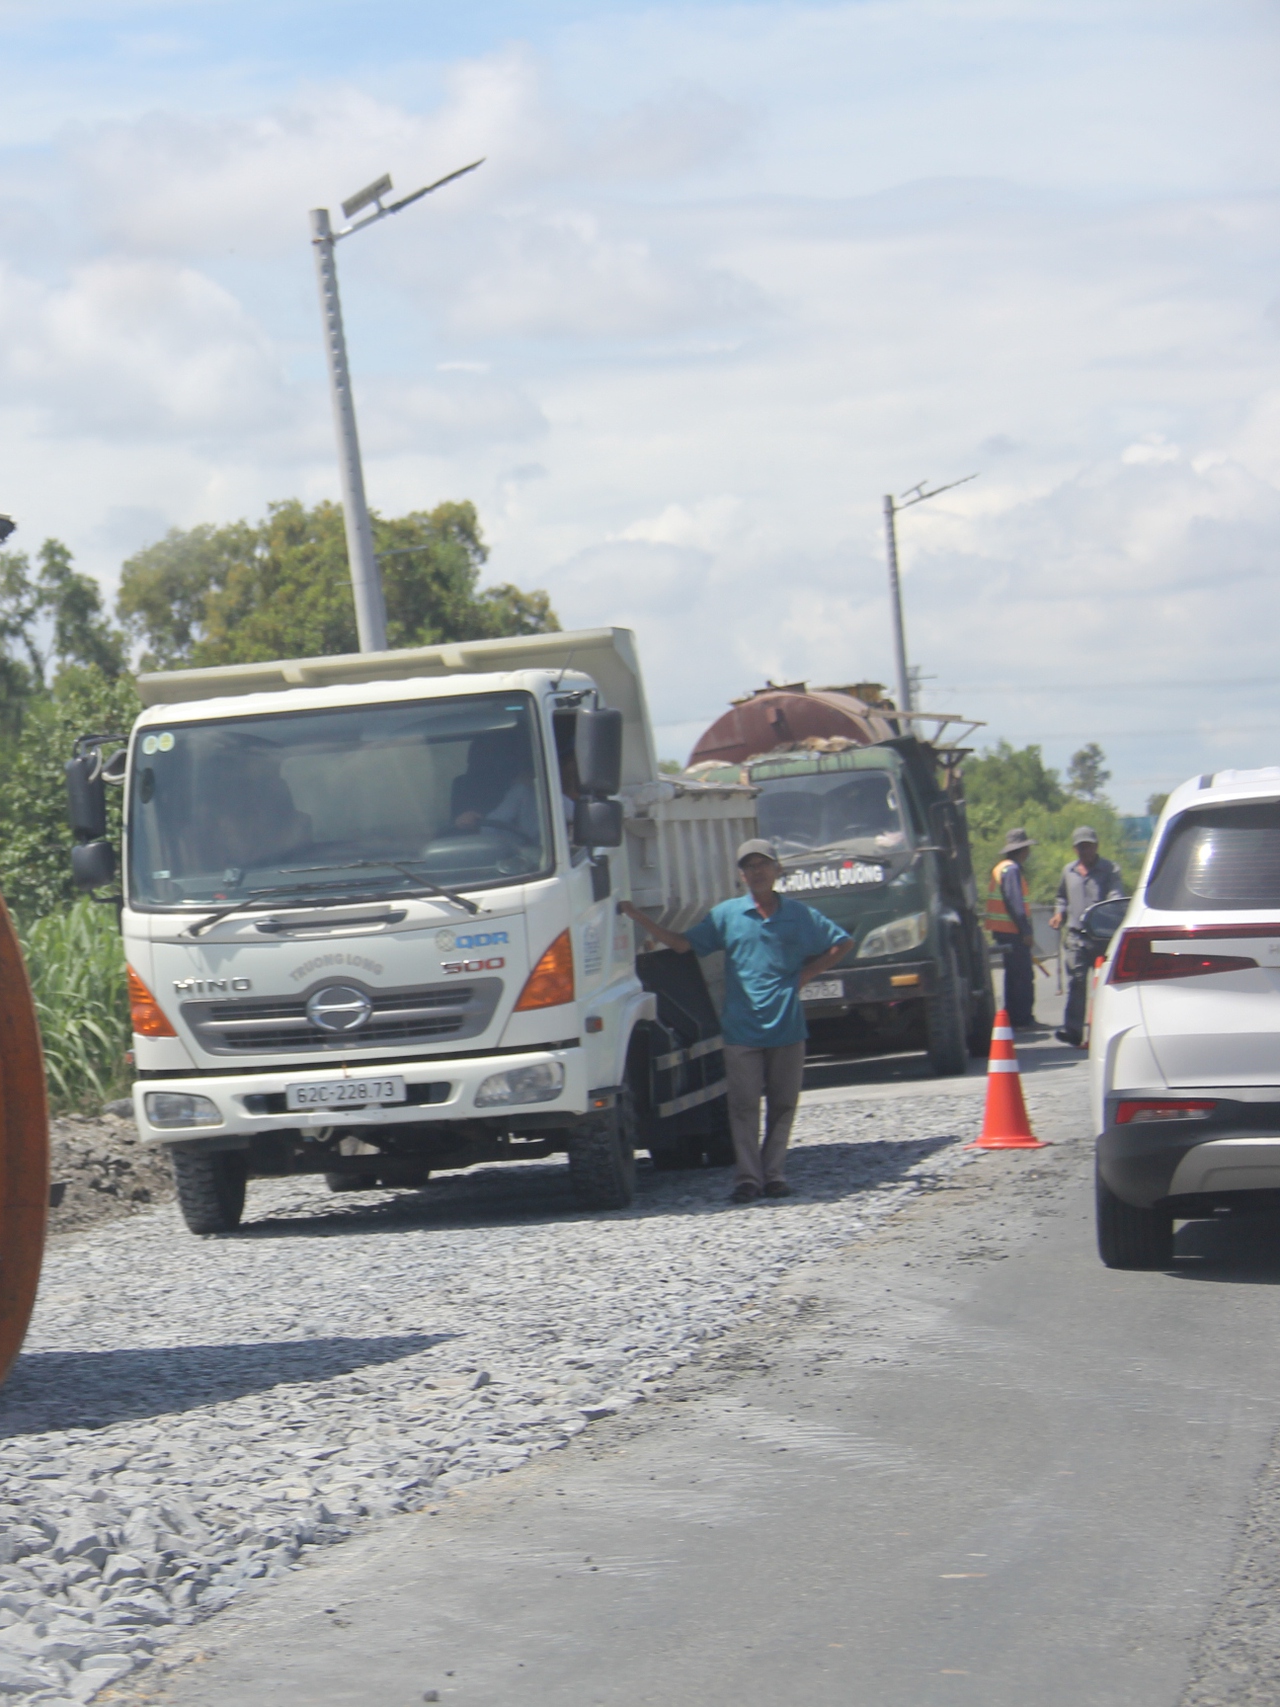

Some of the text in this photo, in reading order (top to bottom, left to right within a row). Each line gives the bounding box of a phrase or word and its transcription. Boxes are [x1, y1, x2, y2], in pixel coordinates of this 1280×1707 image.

[455, 931, 509, 949] QDR
[346, 953, 384, 976] LONG
[440, 957, 505, 975] 500
[172, 976, 252, 995] HINO
[296, 1081, 394, 1103] 62C-228.73
